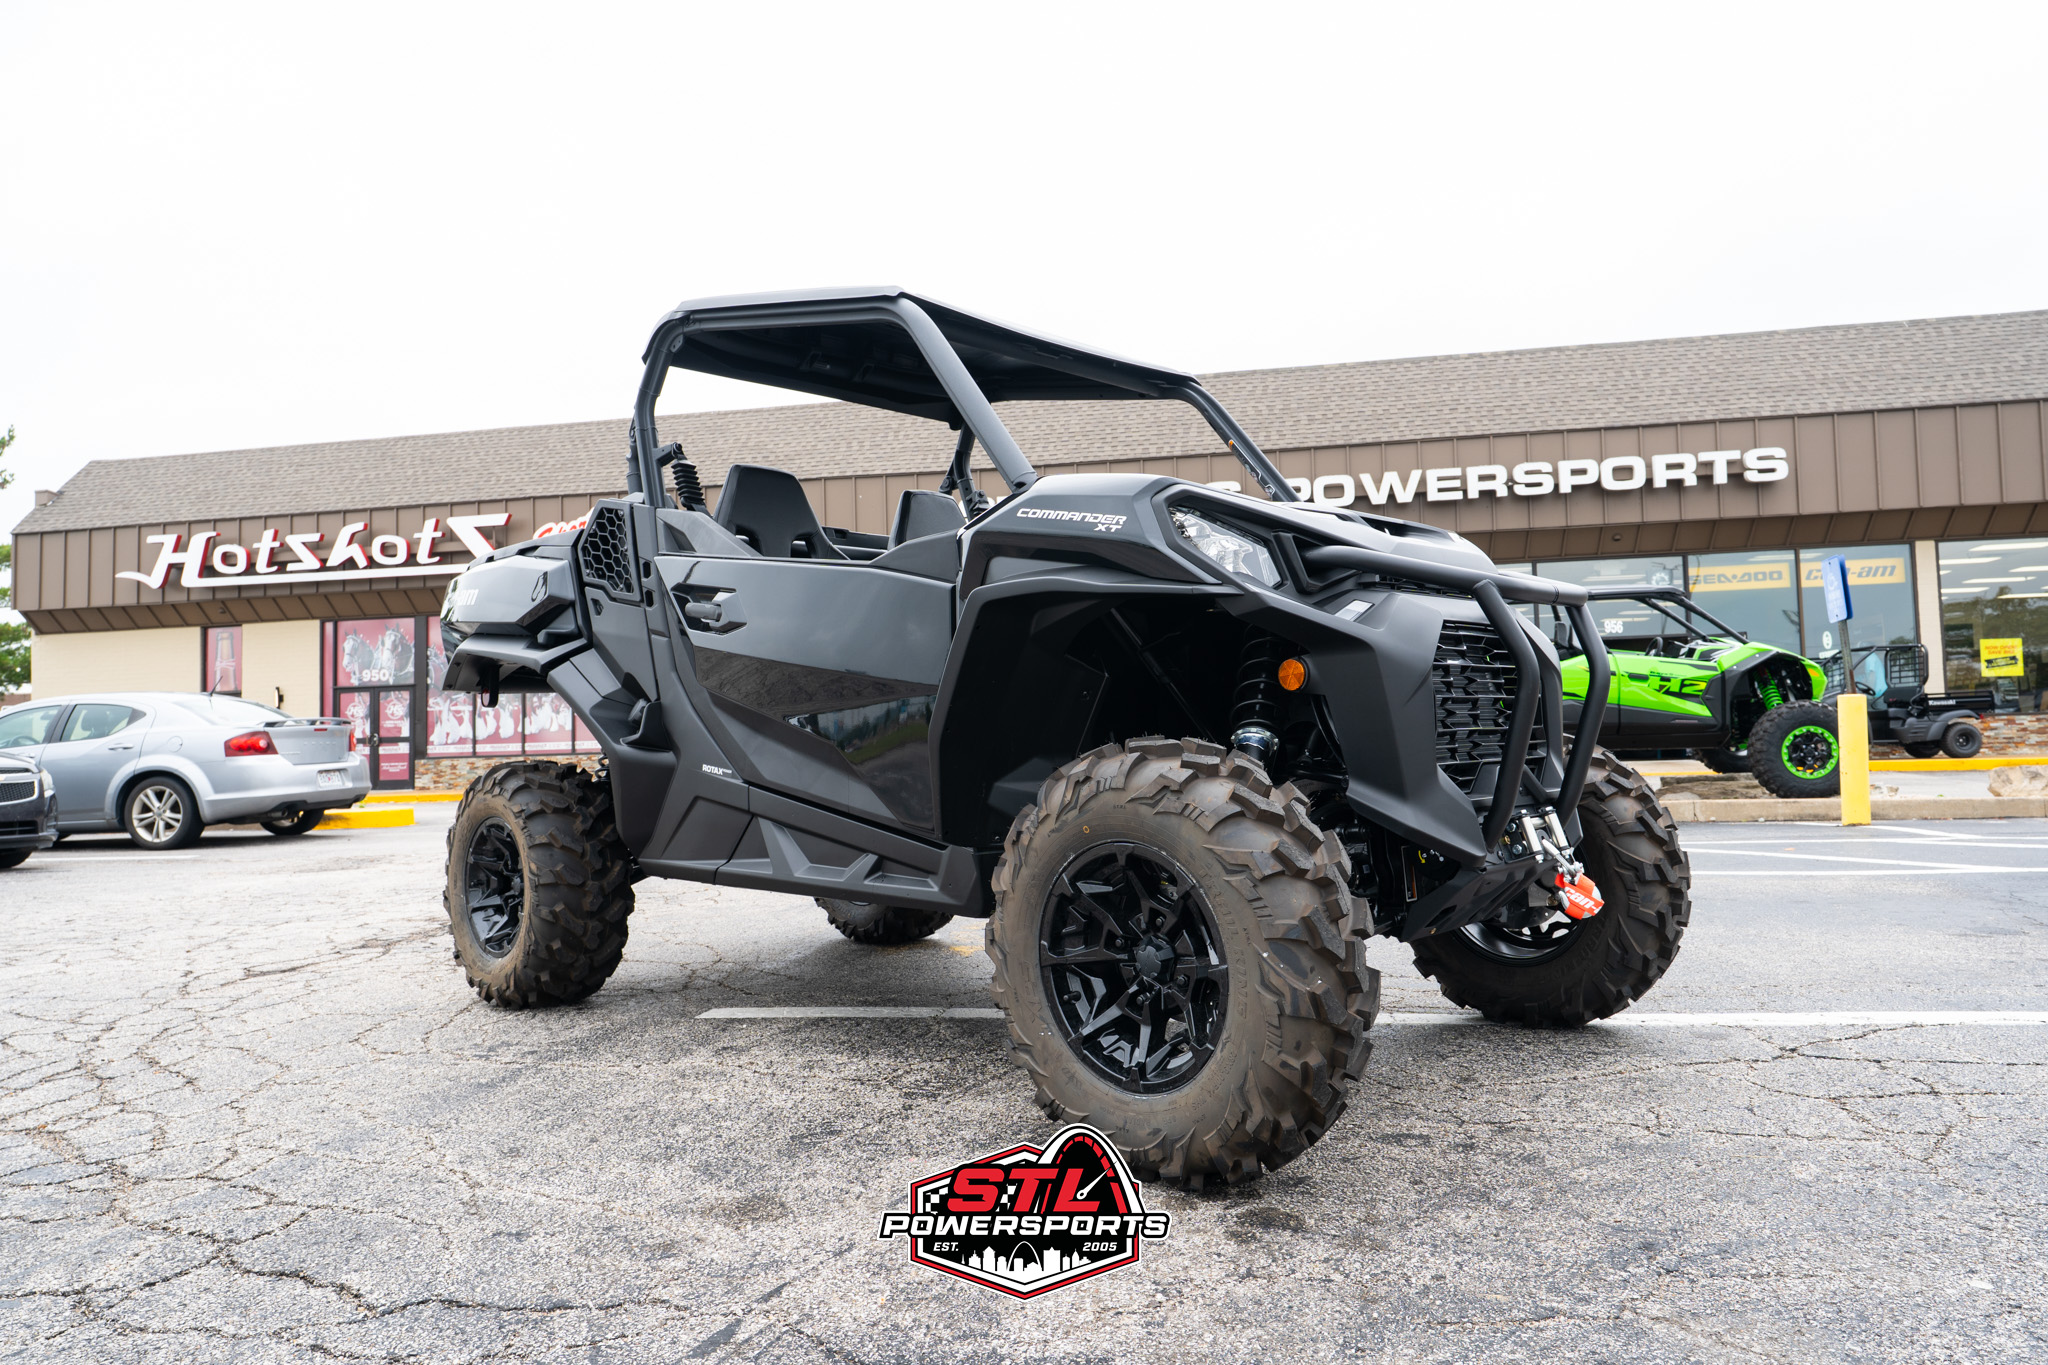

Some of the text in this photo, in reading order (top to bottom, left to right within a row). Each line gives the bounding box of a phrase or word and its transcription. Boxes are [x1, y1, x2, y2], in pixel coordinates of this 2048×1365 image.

[1281, 446, 1790, 507] POWERSPORTS
[1016, 508, 1127, 525] COMMANDER
[1093, 522, 1123, 533] XT
[1805, 564, 1897, 581] c-am
[1604, 620, 1623, 634] 956
[362, 669, 389, 682] 950
[702, 763, 723, 776] ROTAX
